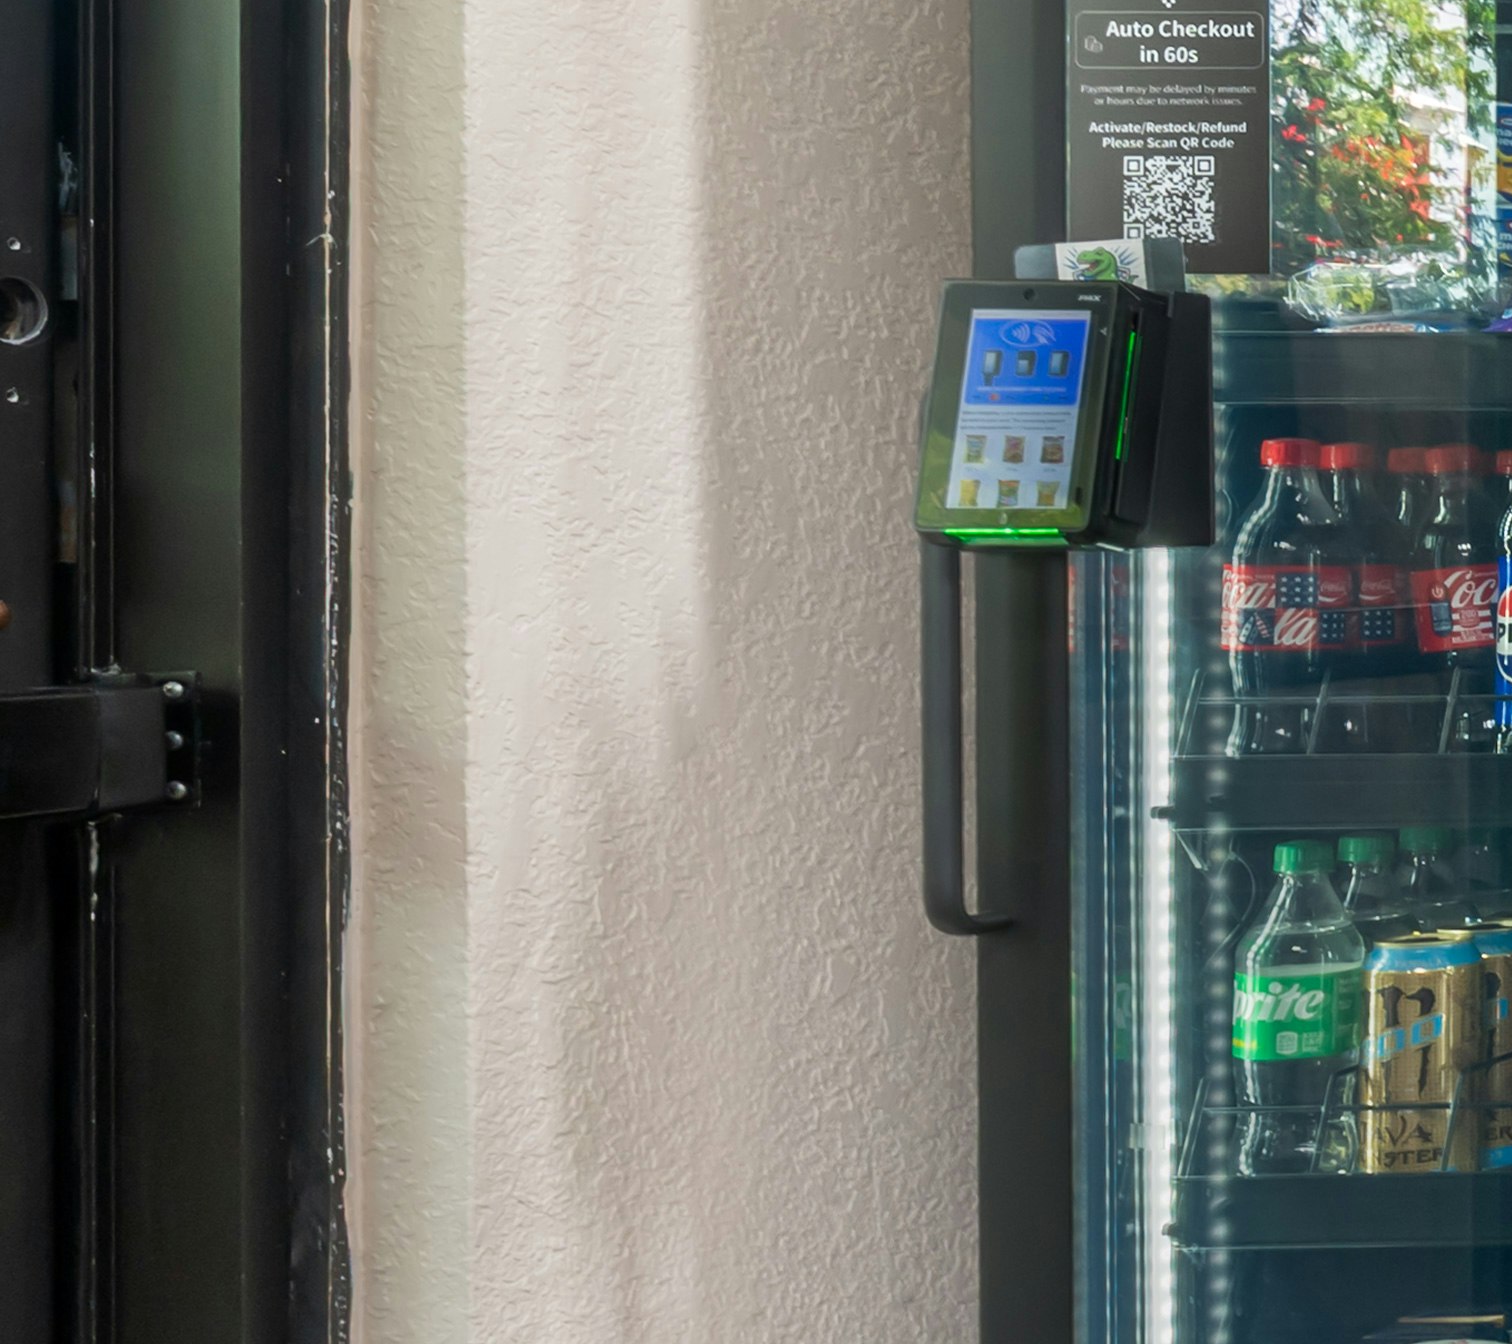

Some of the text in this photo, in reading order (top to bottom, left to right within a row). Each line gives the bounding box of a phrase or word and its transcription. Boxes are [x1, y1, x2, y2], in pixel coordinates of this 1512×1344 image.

[1106, 20, 1254, 39] Auto Checkout
[1140, 45, 1198, 63] in 60s
[1081, 84, 1124, 94] Payment
[1126, 86, 1146, 95] may
[1150, 84, 1161, 94] be
[1163, 84, 1202, 95] delayed
[1204, 84, 1215, 95] by
[1107, 96, 1134, 105] hours
[1136, 96, 1155, 105] due
[1158, 97, 1167, 105] to
[1169, 96, 1209, 105] network
[1089, 122, 1247, 135] Activate/Restock/Refund
[1102, 137, 1235, 150] Please Scan QR Code
